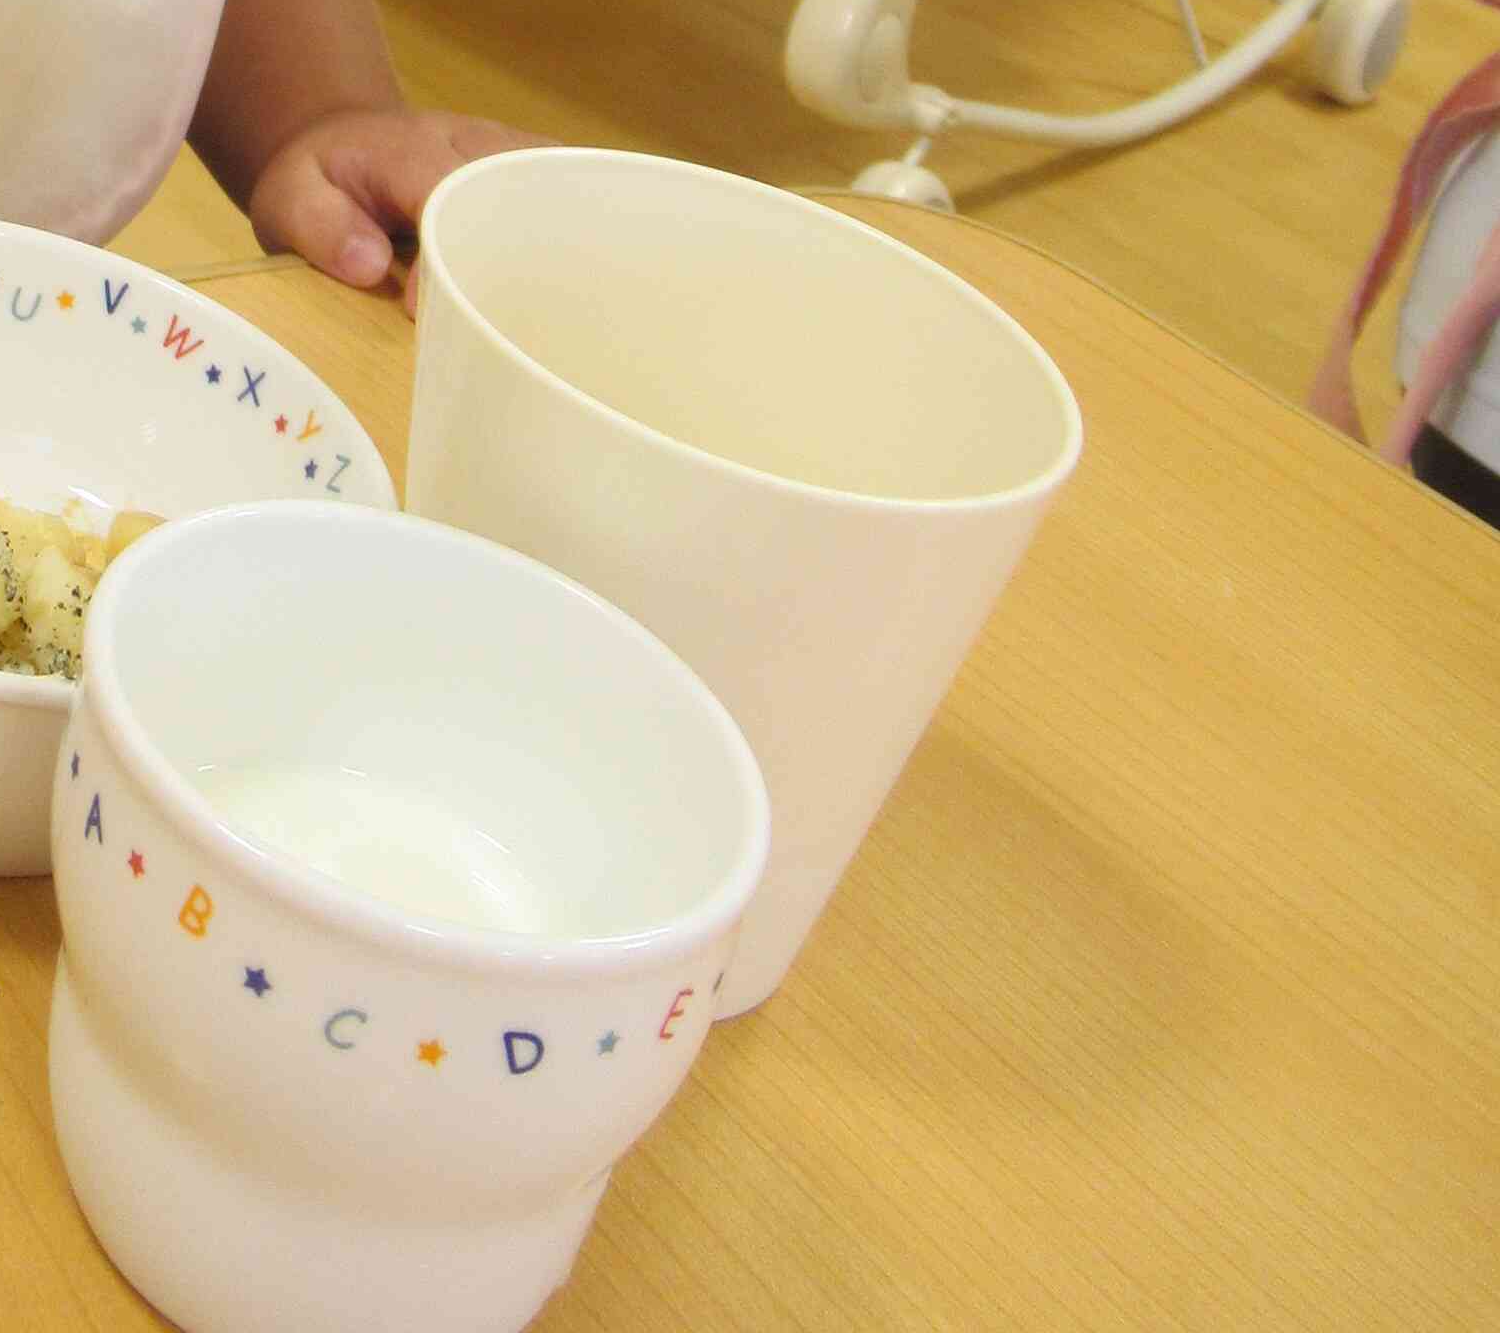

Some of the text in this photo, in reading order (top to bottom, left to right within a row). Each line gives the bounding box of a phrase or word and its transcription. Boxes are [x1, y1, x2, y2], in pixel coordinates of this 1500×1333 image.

[10, 286, 42, 322] U
[103, 277, 130, 316] V
[162, 313, 205, 361] W
[236, 364, 266, 408] X
[296, 409, 324, 442] Y
[325, 453, 353, 494] Z
[83, 791, 694, 1075] A B C D E
